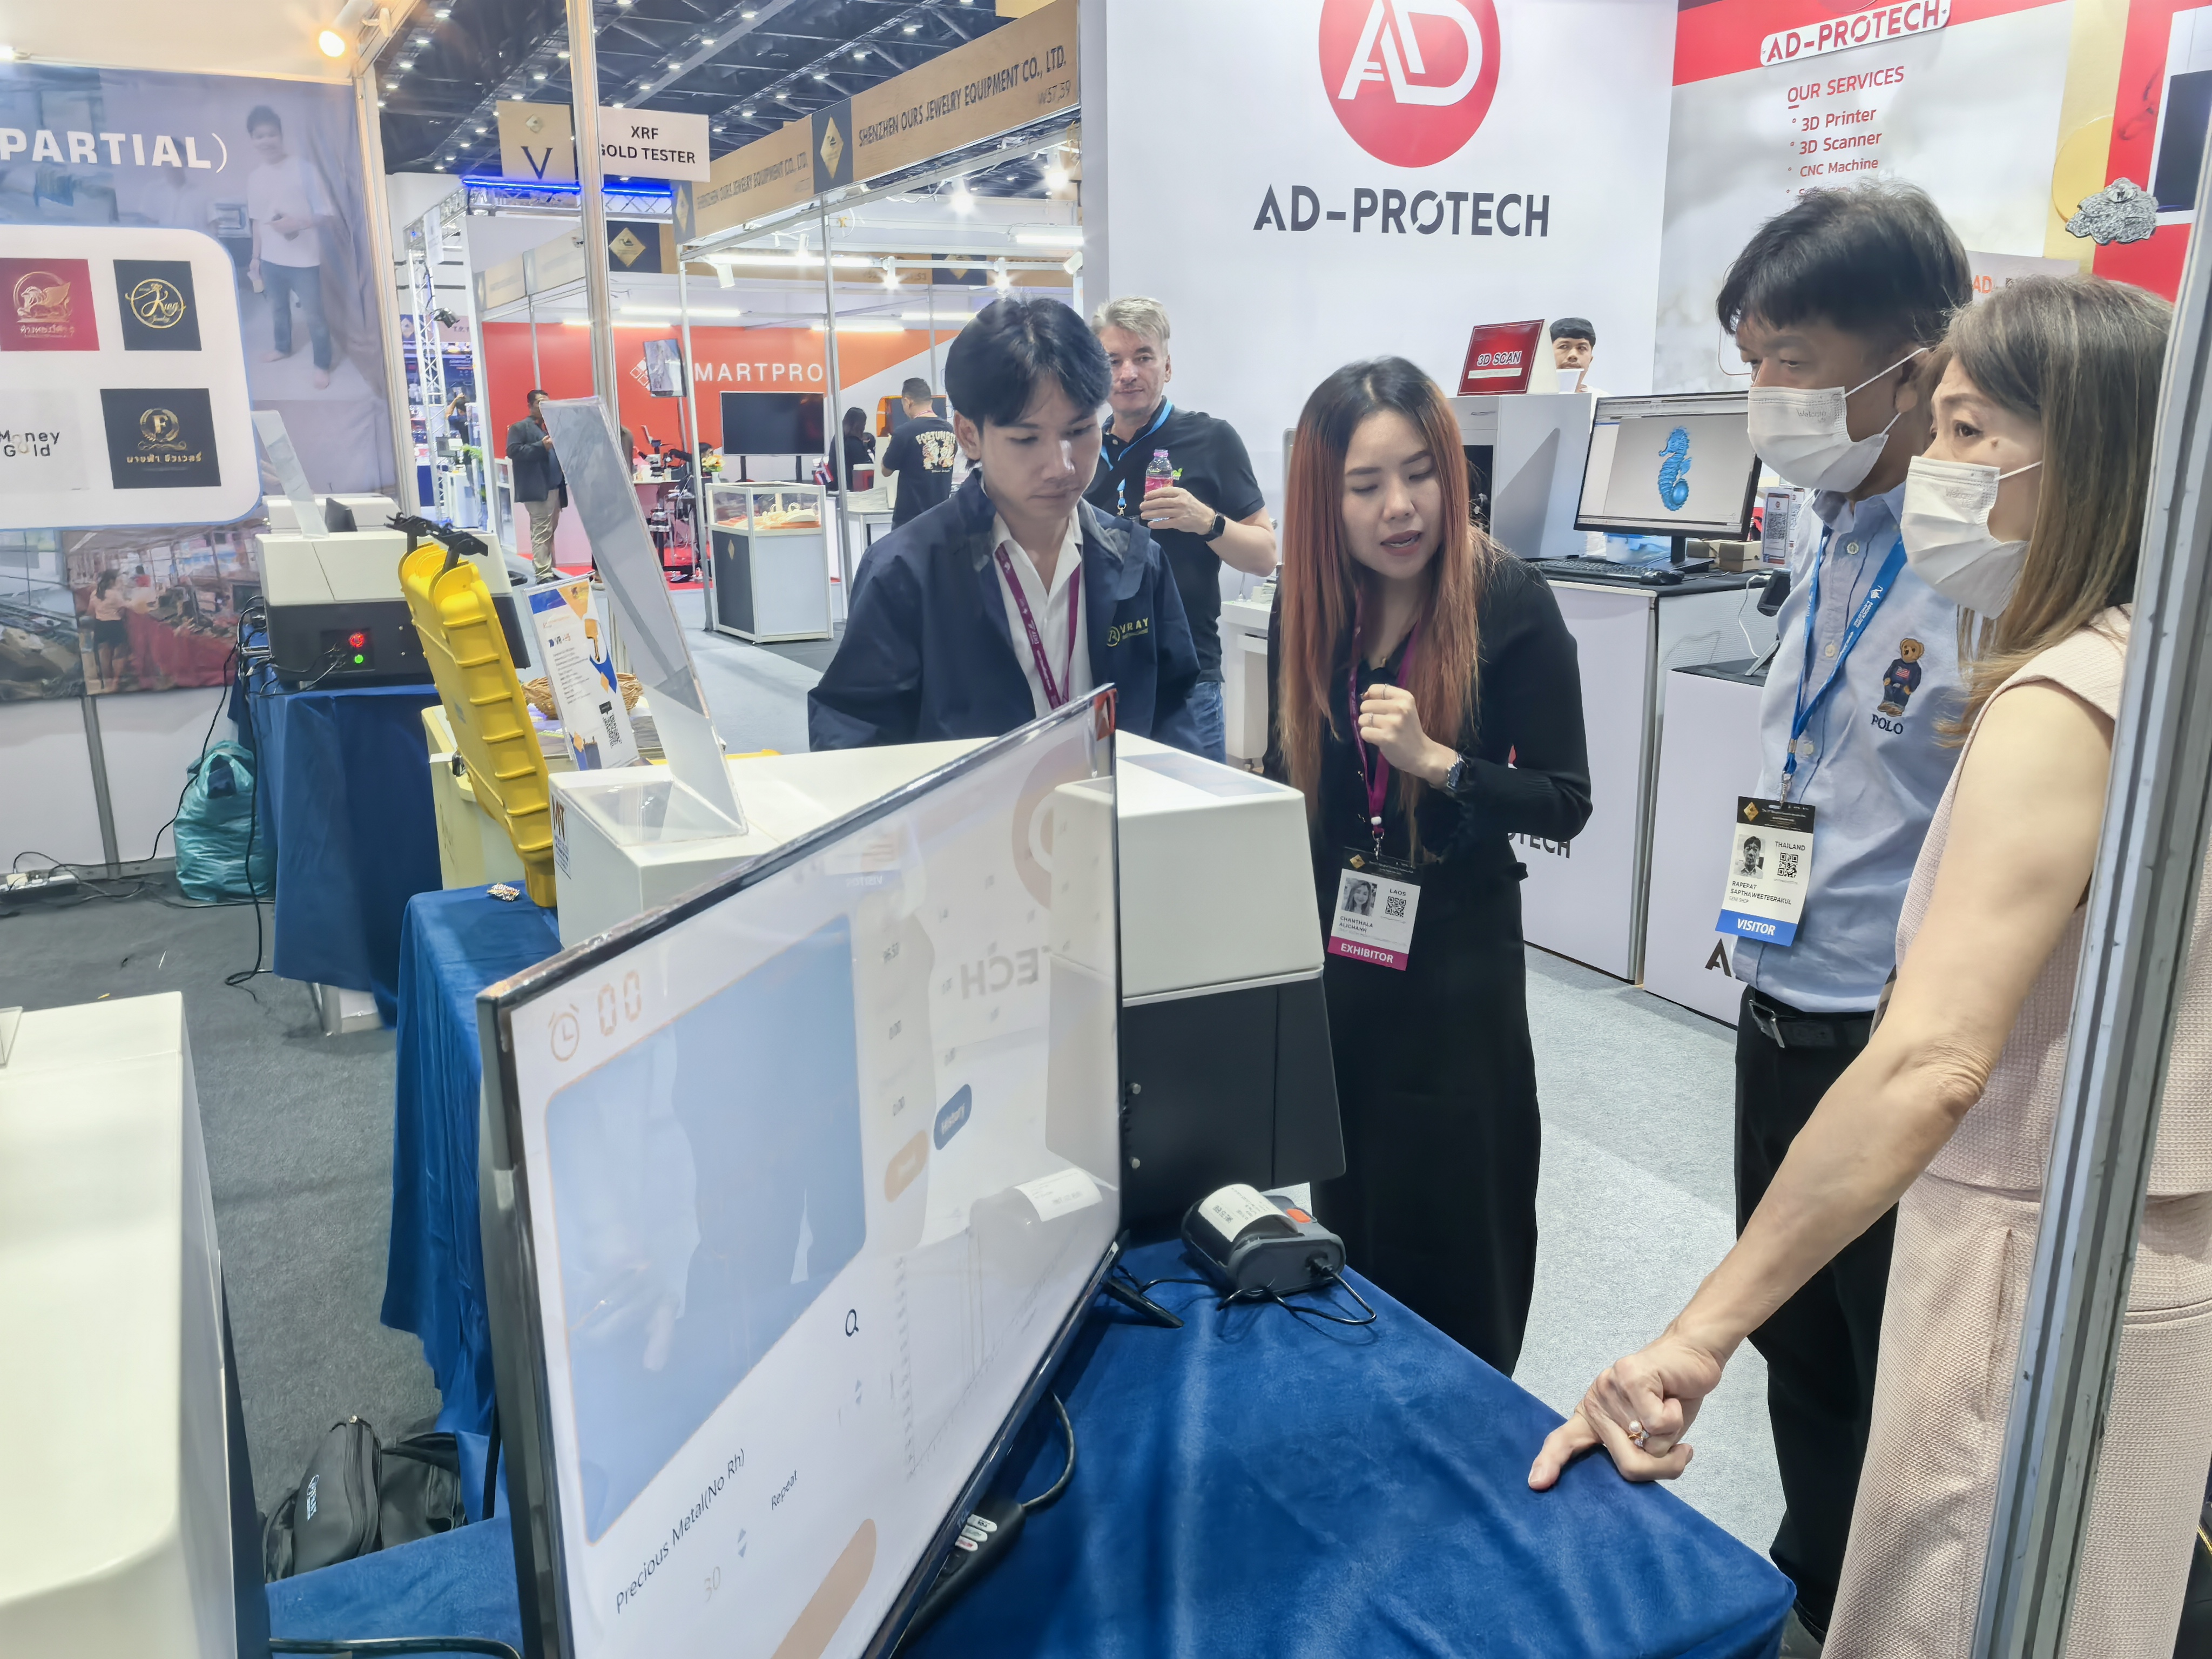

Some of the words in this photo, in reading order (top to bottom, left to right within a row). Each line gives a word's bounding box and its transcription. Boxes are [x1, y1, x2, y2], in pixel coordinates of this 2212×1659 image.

[1766, 0, 1939, 63] AD-PROTECH
[1788, 83, 1820, 103] OUR
[1826, 65, 1904, 96] SERVICES
[859, 117, 899, 147] SHENZHEN
[901, 104, 923, 131] OURS
[925, 88, 961, 122] JEWELRY
[965, 63, 1021, 106] EQUIPMENT
[1801, 116, 1819, 132] 3D
[1825, 109, 1877, 128] Printer
[631, 126, 659, 140] XRF
[1799, 139, 1818, 155] 3D
[1823, 133, 1882, 152] Scanner
[521, 146, 553, 180] V
[641, 147, 696, 164] TESTER
[1800, 164, 1824, 177] CNC
[1828, 158, 1879, 174] Machine
[1253, 184, 1550, 237] AD-PROTECH
[1476, 353, 1492, 366] 3D
[1492, 350, 1522, 366] SCAN
[694, 363, 822, 382] MARTPRO
[1871, 713, 1904, 734] POLO
[1775, 841, 1806, 851] THAILAND
[1389, 888, 1406, 896] LAOS
[1340, 916, 1373, 928] CHANTHALA
[1737, 918, 1776, 936] VISITOR
[1340, 942, 1394, 964] EXHIBITOR
[770, 1469, 799, 1511] Repeat
[615, 1543, 670, 1615] Precious
[670, 1476, 725, 1543] Metal(No
[727, 1447, 746, 1481] Rh)
